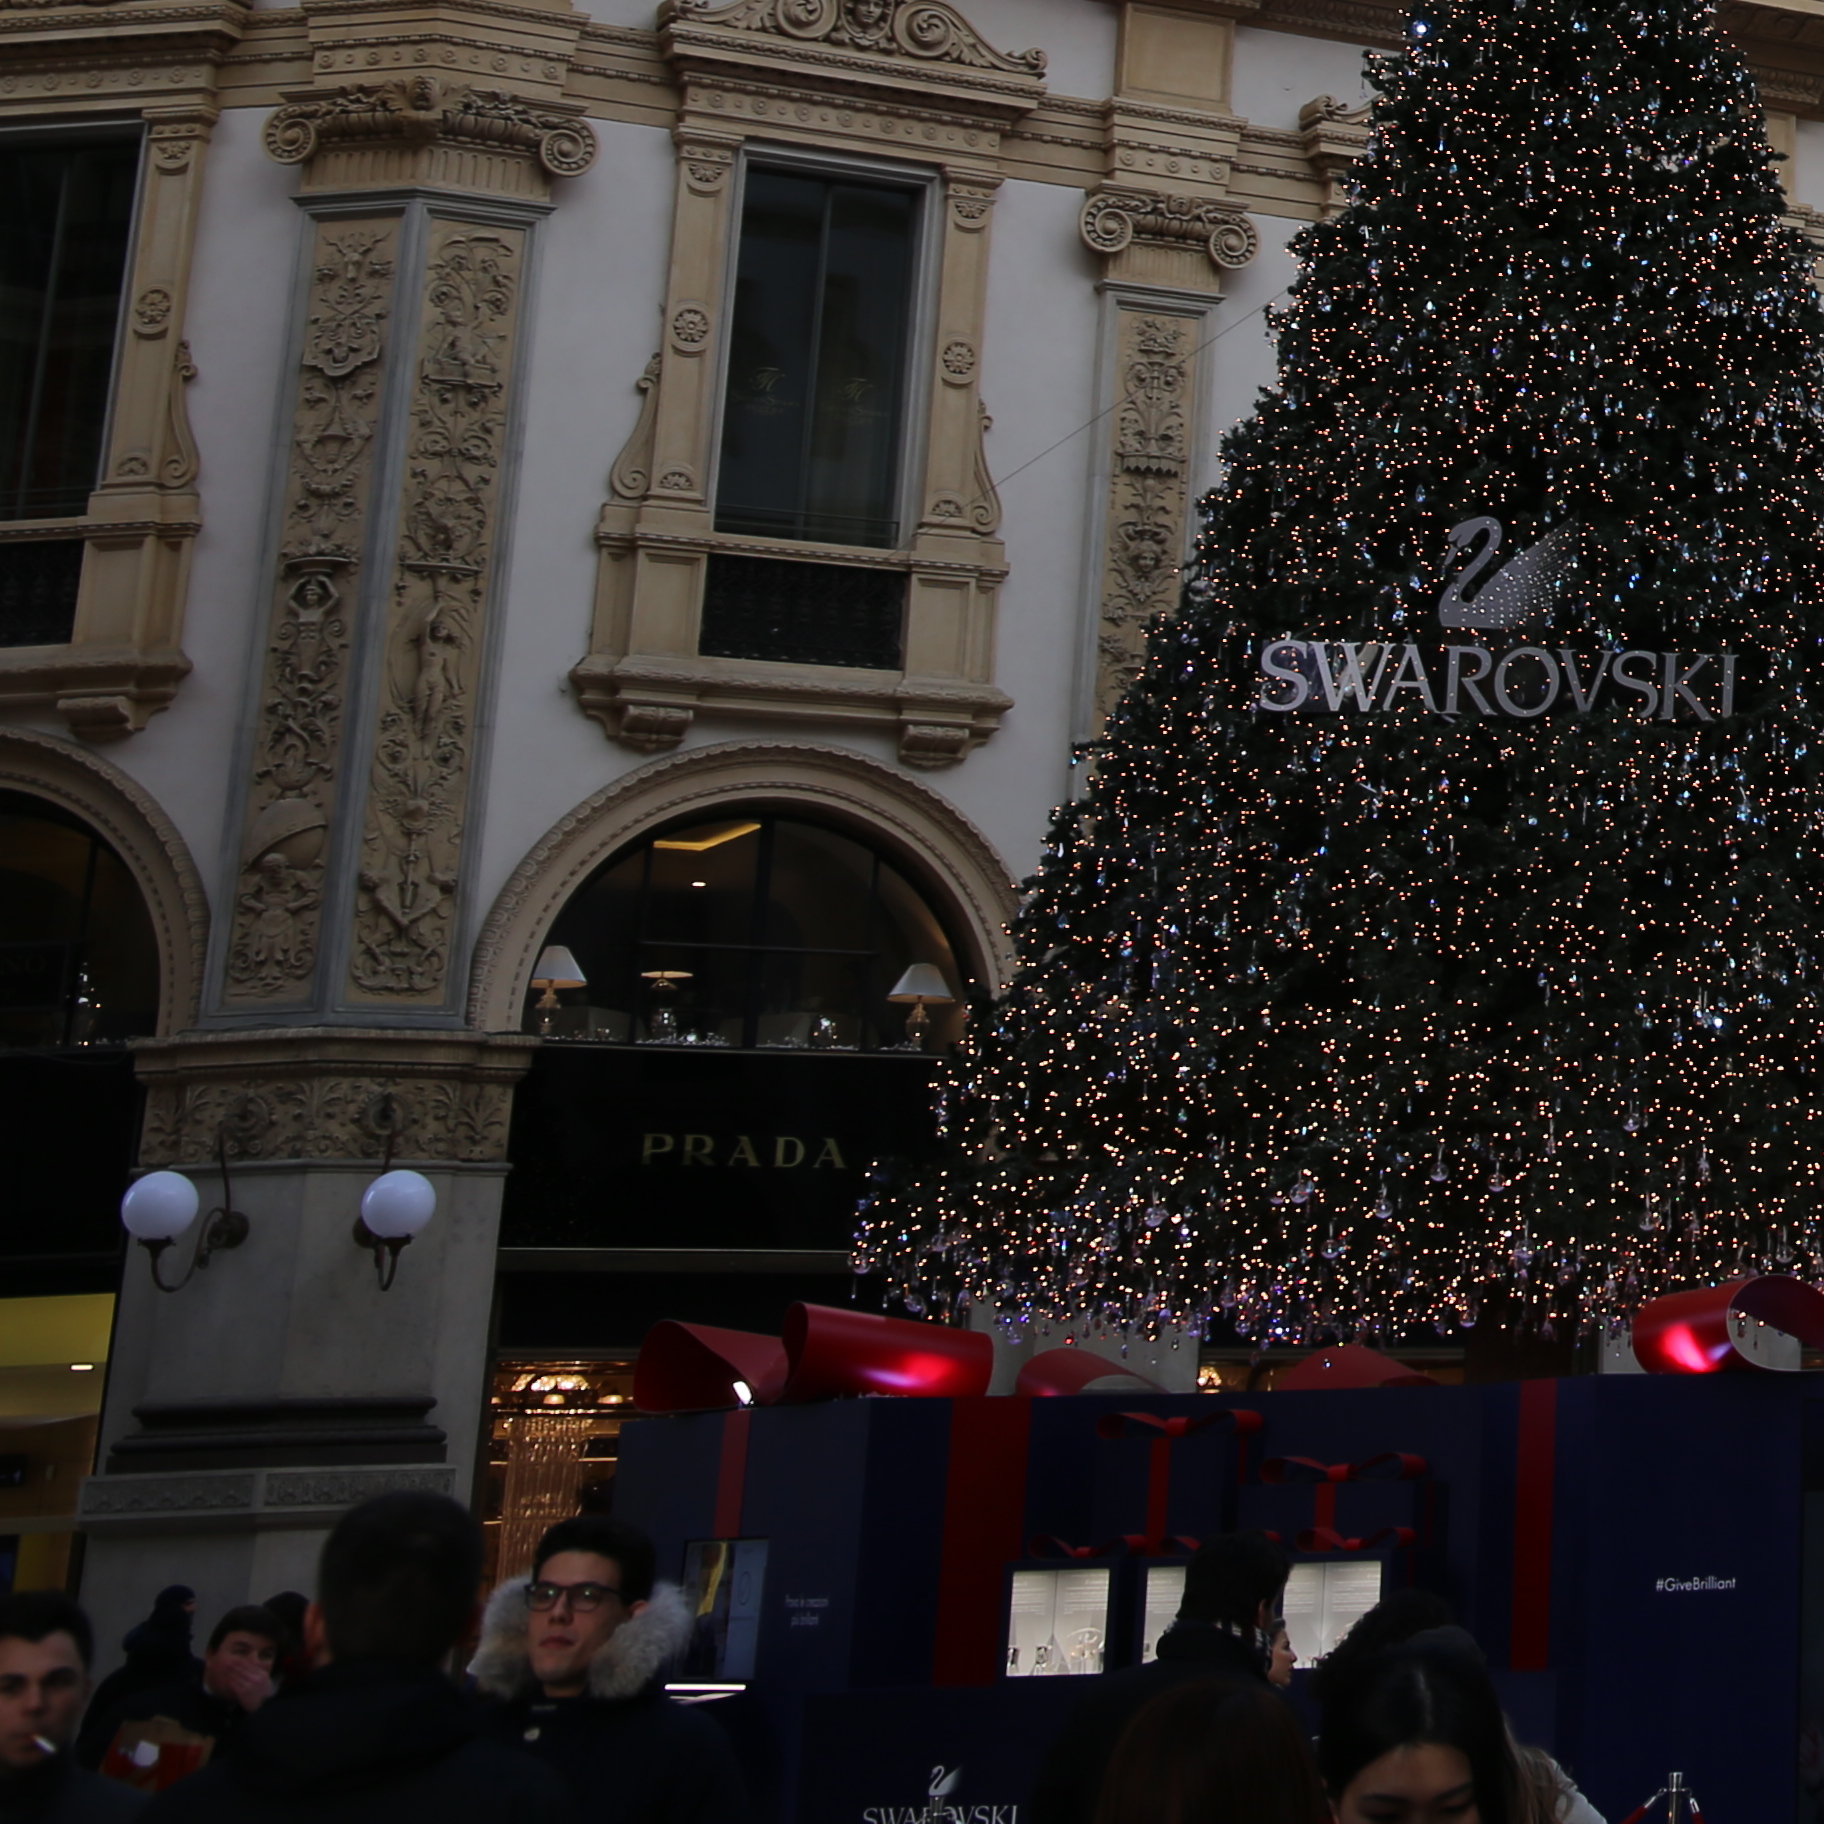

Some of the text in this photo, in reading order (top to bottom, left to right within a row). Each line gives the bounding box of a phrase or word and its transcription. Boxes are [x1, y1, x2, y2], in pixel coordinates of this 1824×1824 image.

[1259, 639, 1739, 722] SWAROVSKI
[640, 1132, 848, 1170] PRADA
[1655, 1575, 1736, 1592] #GiveBrilliant
